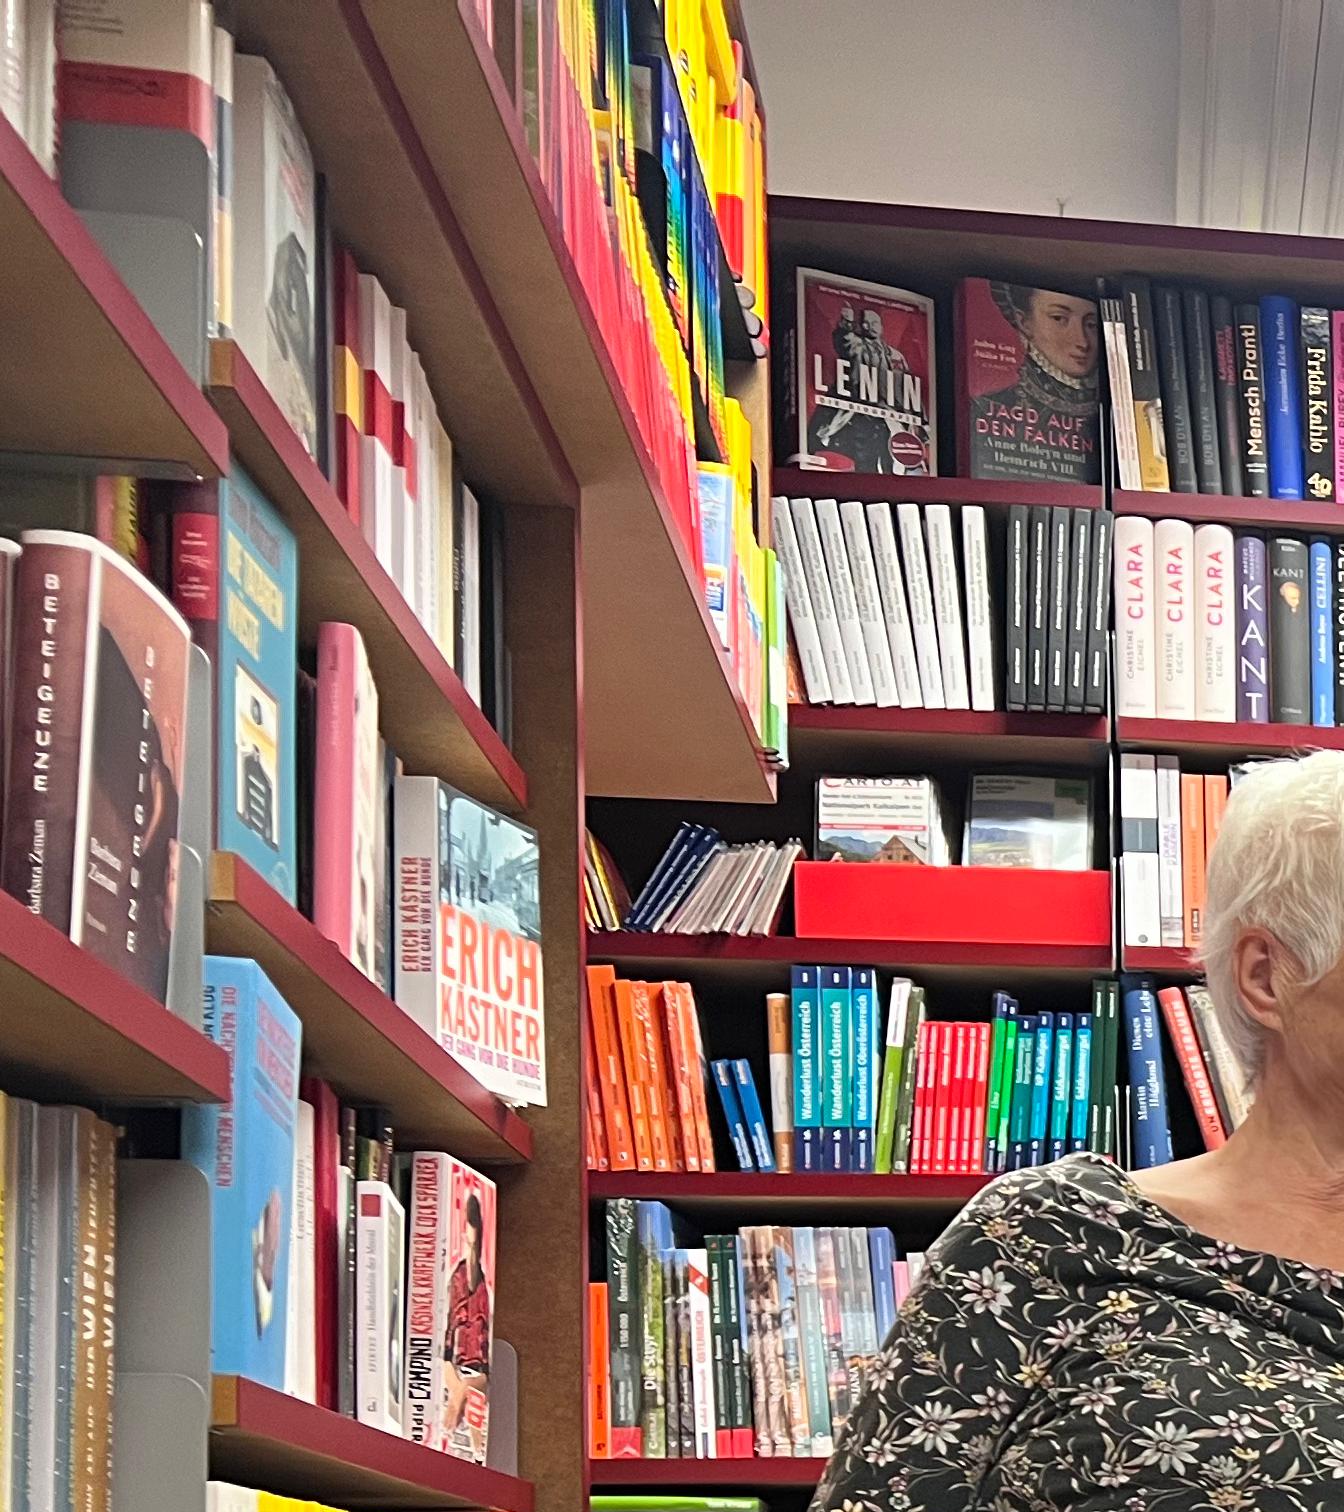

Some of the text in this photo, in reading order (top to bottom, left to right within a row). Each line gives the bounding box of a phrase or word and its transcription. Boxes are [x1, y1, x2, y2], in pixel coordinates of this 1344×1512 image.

[814, 353, 922, 414] LENIN
[985, 401, 1084, 432] JAGD AUF
[1175, 404, 1188, 437] DYLAN
[1202, 406, 1213, 437] DYLAN
[1240, 324, 1263, 456] Mensch Prantl
[1307, 348, 1330, 454] Frida Kahlo
[975, 418, 1094, 451] DEN FALKEN
[1127, 543, 1144, 620] CLARA
[1167, 546, 1183, 623] CLARA
[1207, 550, 1224, 626] CLARA
[1273, 568, 1304, 578] KANT
[1316, 556, 1327, 609] CELLINI
[33, 572, 61, 794] BETEIGEUZE
[1240, 583, 1267, 719] KANT
[126, 645, 155, 954] BETEIGEUZE
[28, 819, 45, 864] Zeman
[401, 928, 420, 973] ERICH
[440, 903, 539, 1012] ERICH
[440, 982, 540, 1062] KÄSTNER
[1131, 1018, 1142, 1051] Dieses
[800, 1001, 812, 1120] Wanderlust Österreich
[830, 1001, 843, 1121] Wanderlust Österreich
[856, 1065, 867, 1121] Wanderlust
[1137, 1085, 1147, 1121] Martin
[82, 1244, 97, 1341] WIEN
[102, 1253, 116, 1348] WIEN
[408, 1337, 432, 1401] CAMPINO
